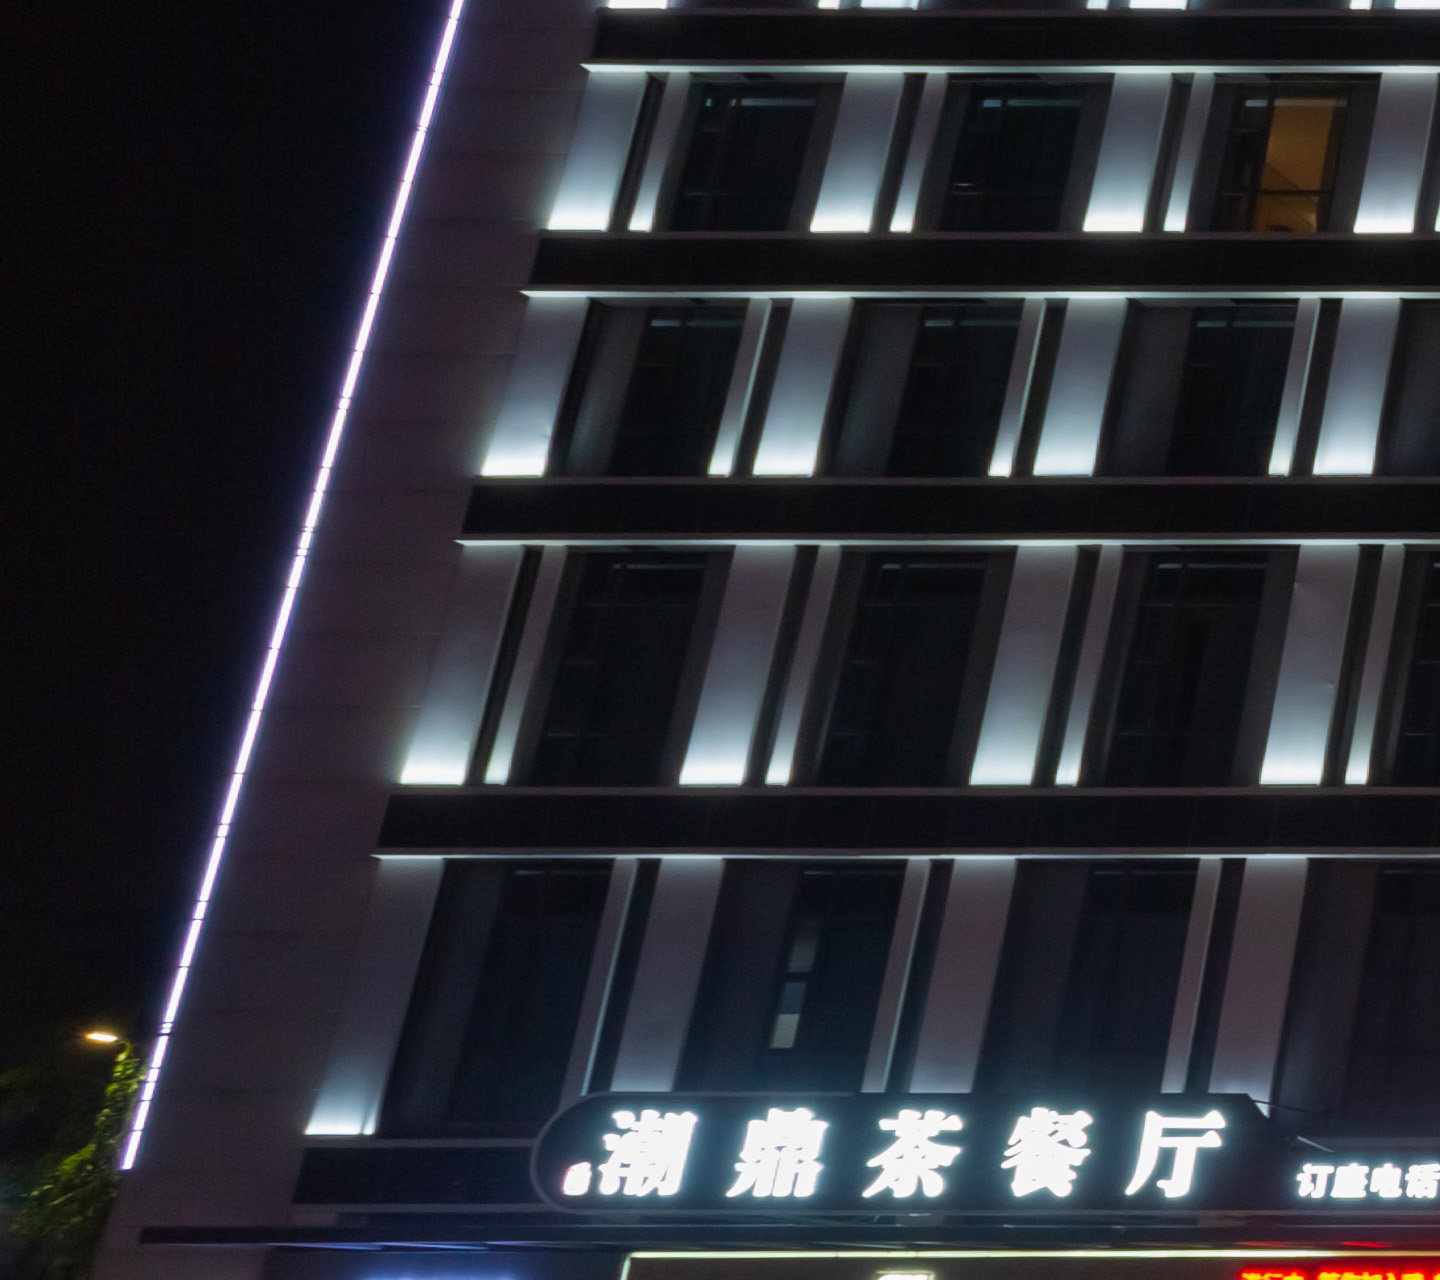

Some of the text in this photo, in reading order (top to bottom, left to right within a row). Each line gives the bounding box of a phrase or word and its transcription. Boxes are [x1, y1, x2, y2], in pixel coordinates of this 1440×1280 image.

[597, 1106, 1227, 1199] 潮鼎茶餐厅
